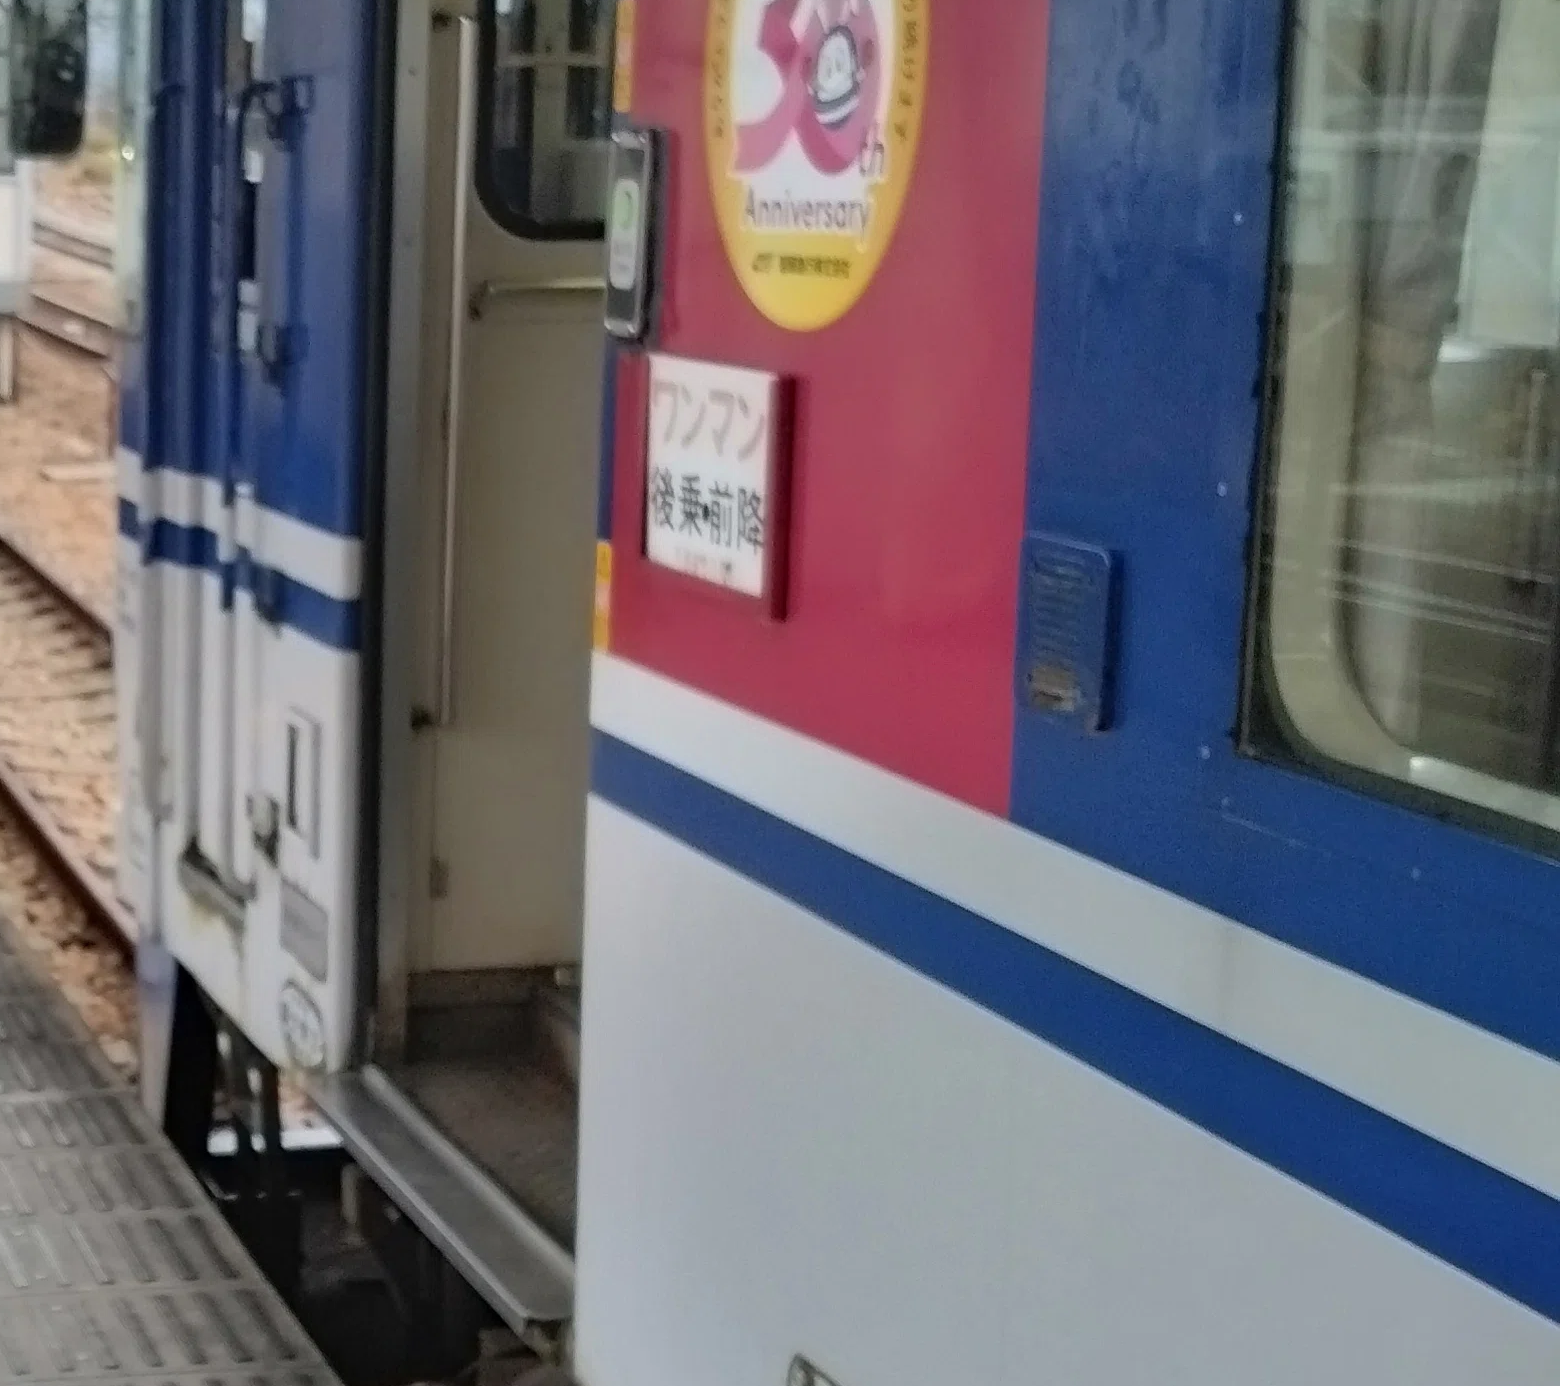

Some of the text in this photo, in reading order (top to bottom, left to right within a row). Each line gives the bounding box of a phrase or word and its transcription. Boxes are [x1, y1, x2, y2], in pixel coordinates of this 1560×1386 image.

[858, 120, 885, 177] th
[744, 185, 869, 243] Anniversary
[652, 380, 766, 462] ワンマン
